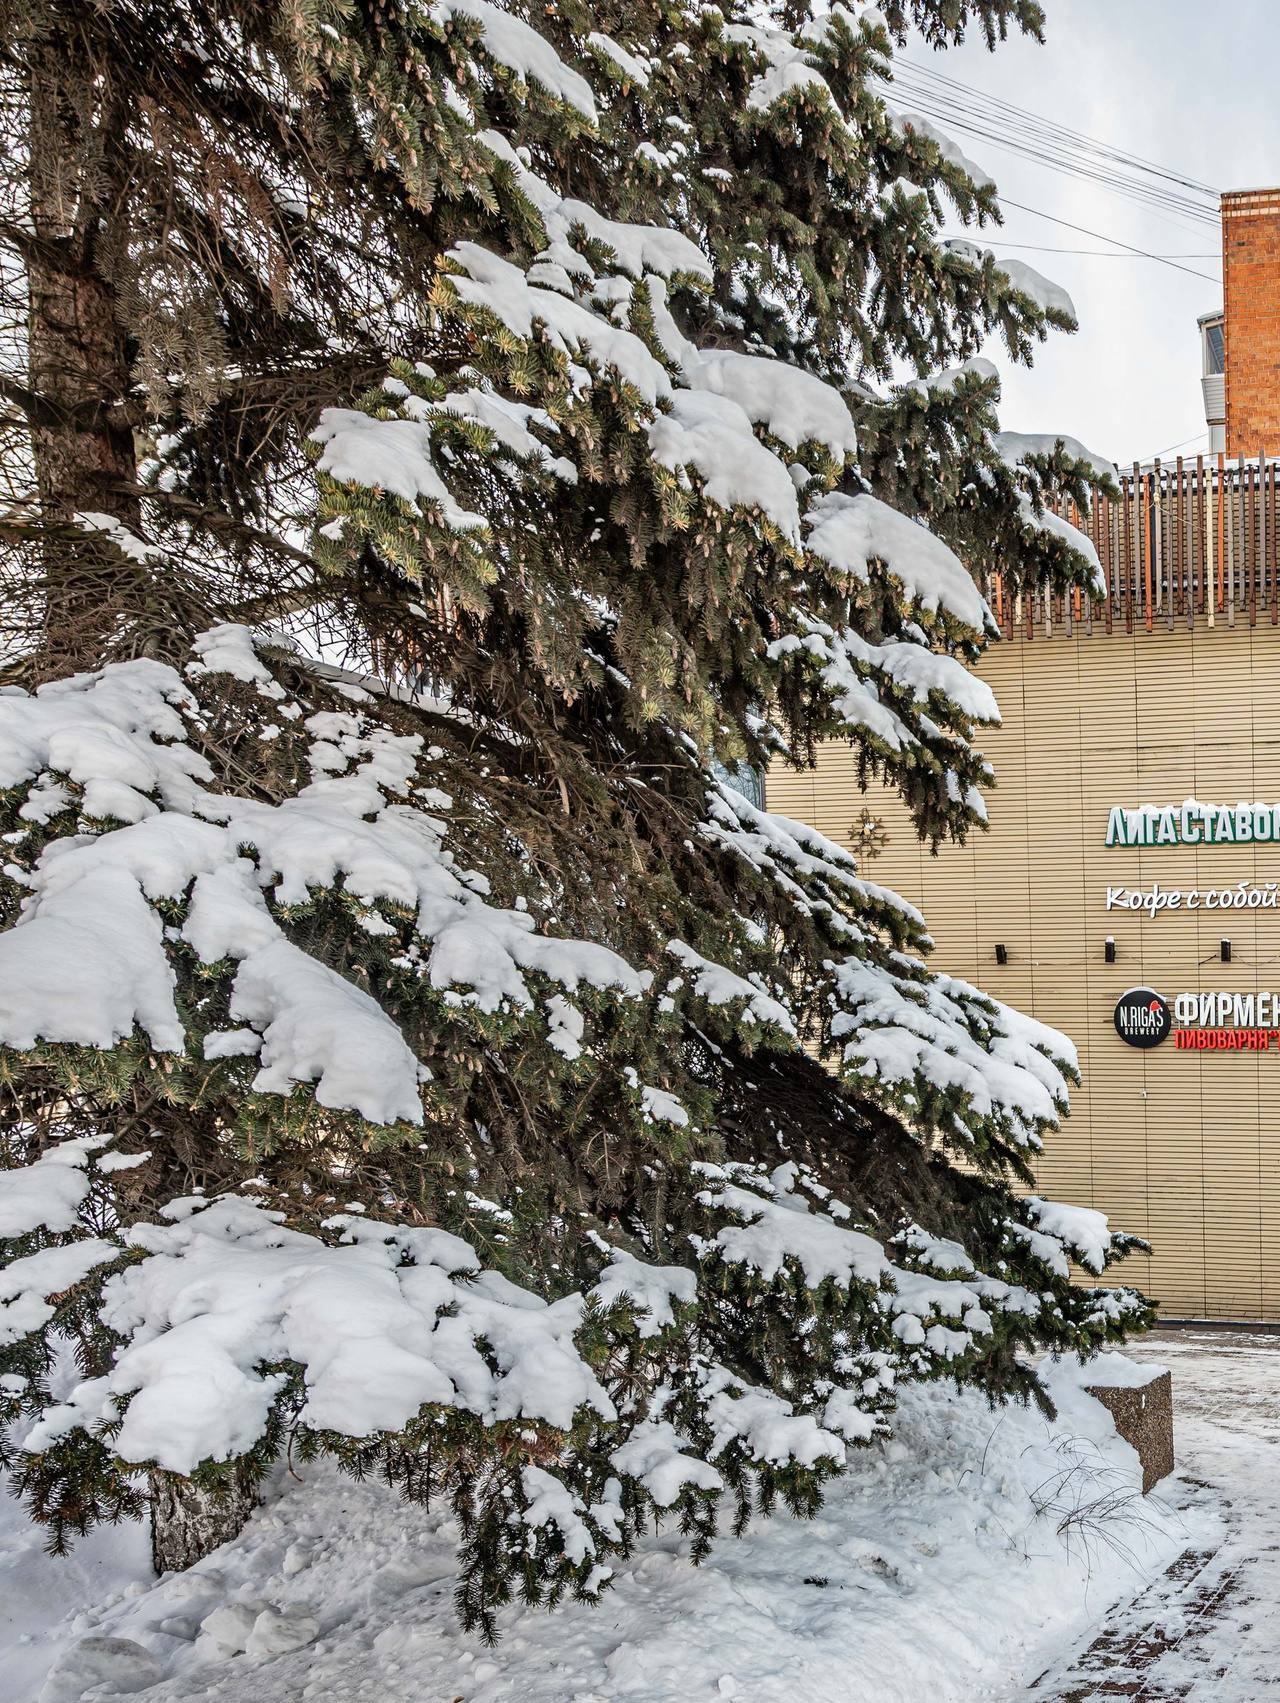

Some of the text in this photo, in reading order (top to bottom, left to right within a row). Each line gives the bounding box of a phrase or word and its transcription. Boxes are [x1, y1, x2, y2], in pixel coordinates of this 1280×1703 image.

[1106, 881, 1279, 919] Кофе с собой
[1124, 1027, 1160, 1036] BREWERY
[1174, 1029, 1269, 1050] ПИВОВАРНЯ
